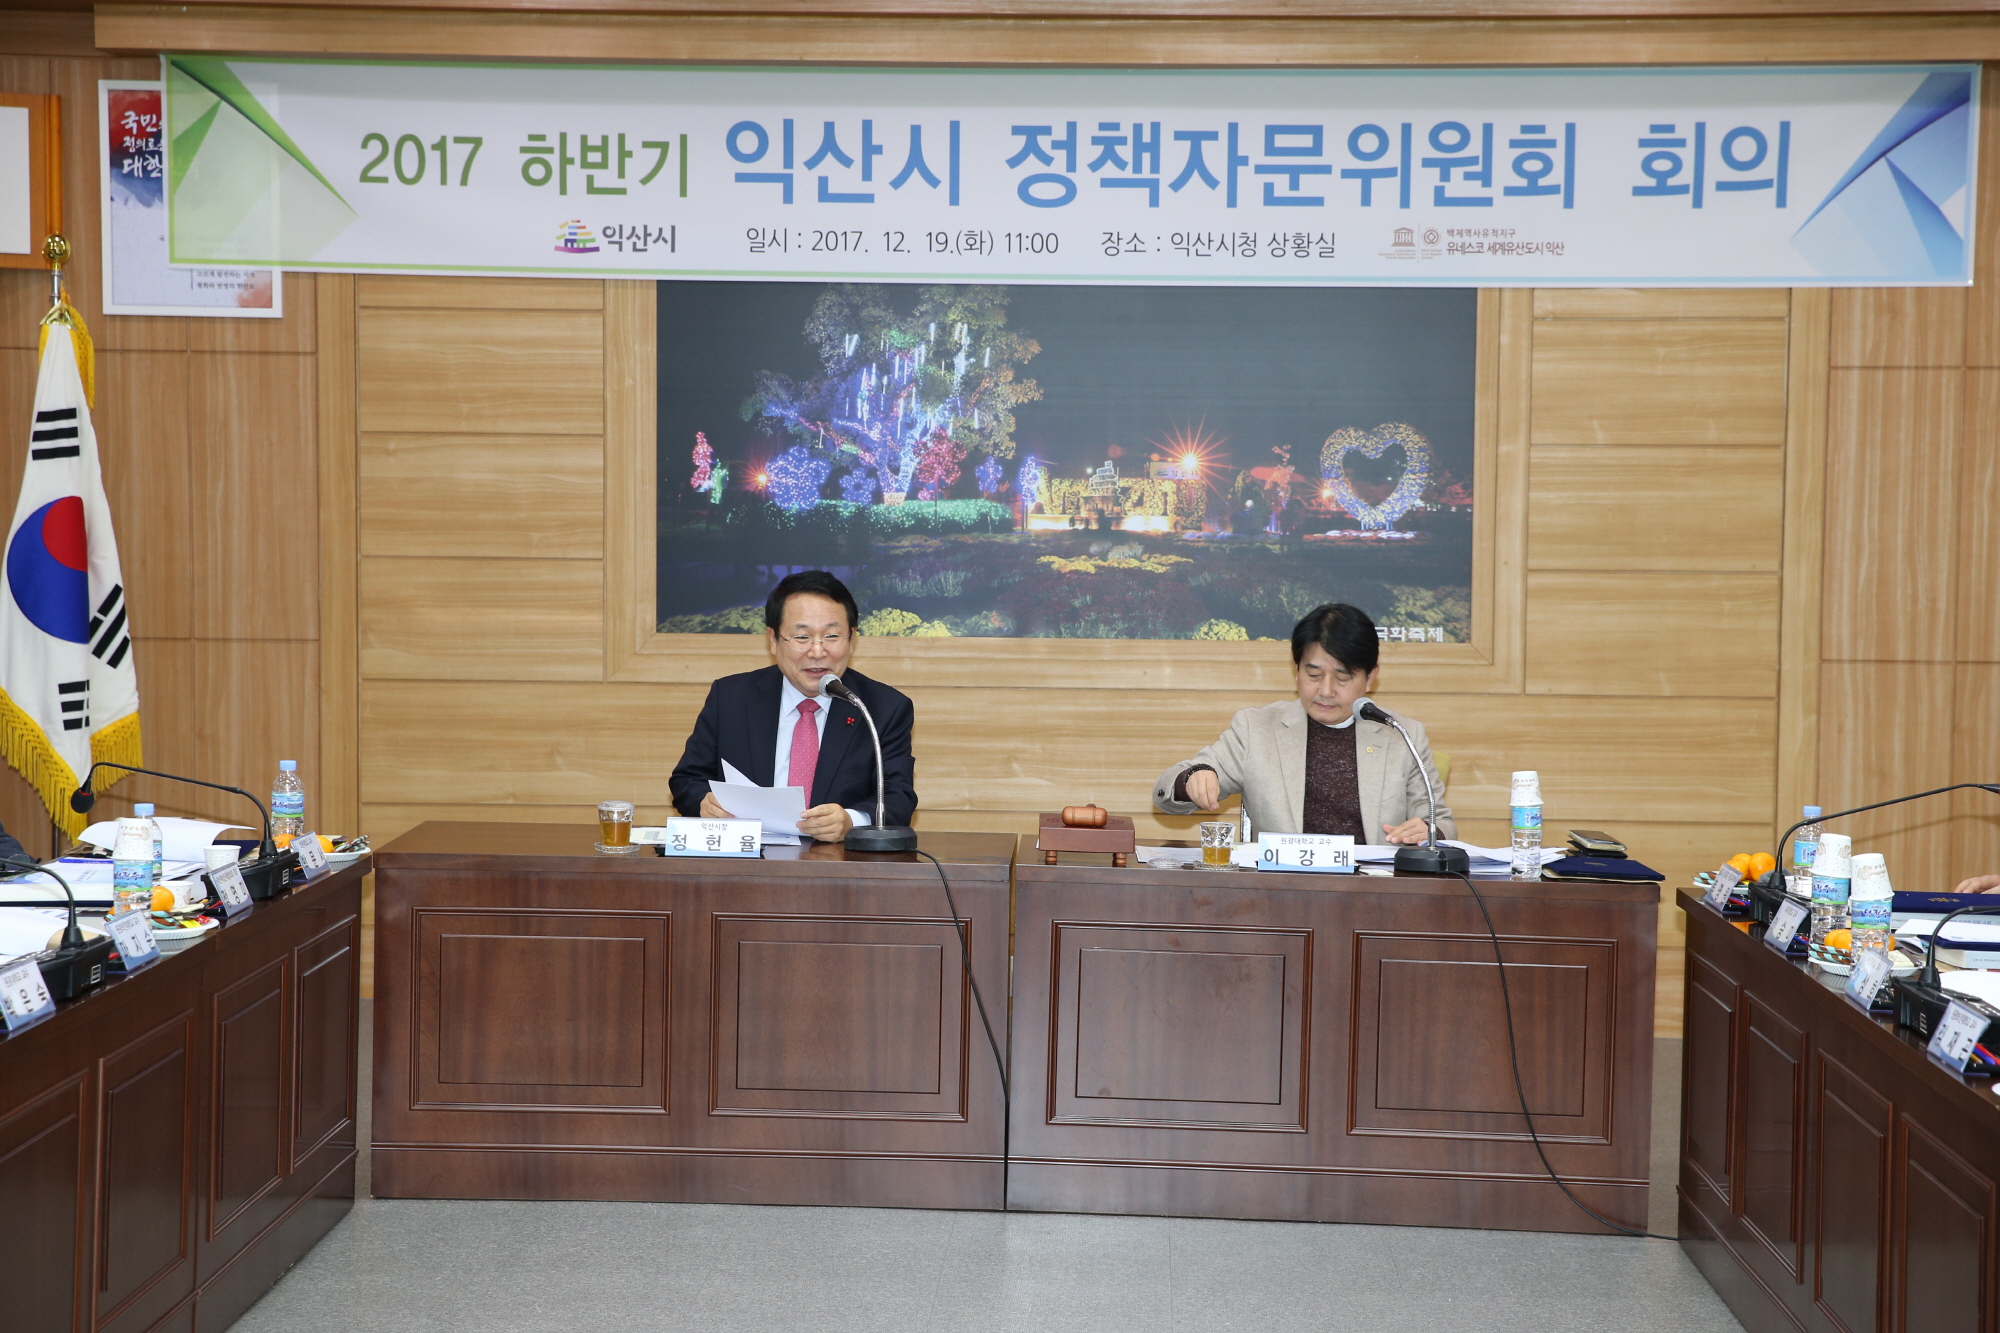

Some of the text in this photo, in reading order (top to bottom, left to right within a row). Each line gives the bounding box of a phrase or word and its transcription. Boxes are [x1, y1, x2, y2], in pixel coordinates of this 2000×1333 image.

[121, 110, 162, 135] 국민
[123, 135, 163, 153] 정의로
[359, 118, 1791, 209] 2017 하반기 익산시 정책자문위원회 회의
[602, 223, 676, 253] 익산시
[746, 227, 788, 253] 일시
[811, 230, 869, 253] 2017.
[882, 231, 911, 253] 12.
[1004, 232, 1059, 254] 11:00
[1100, 231, 1147, 257] 장소
[1170, 232, 1258, 258] 익산시청
[1267, 231, 1336, 258] 상황실
[1446, 241, 1565, 256] 유네스코 세계유산도시 익산
[1375, 626, 1444, 642] 국화축제
[701, 822, 728, 831] 익산시장
[1318, 838, 1332, 846] 교수
